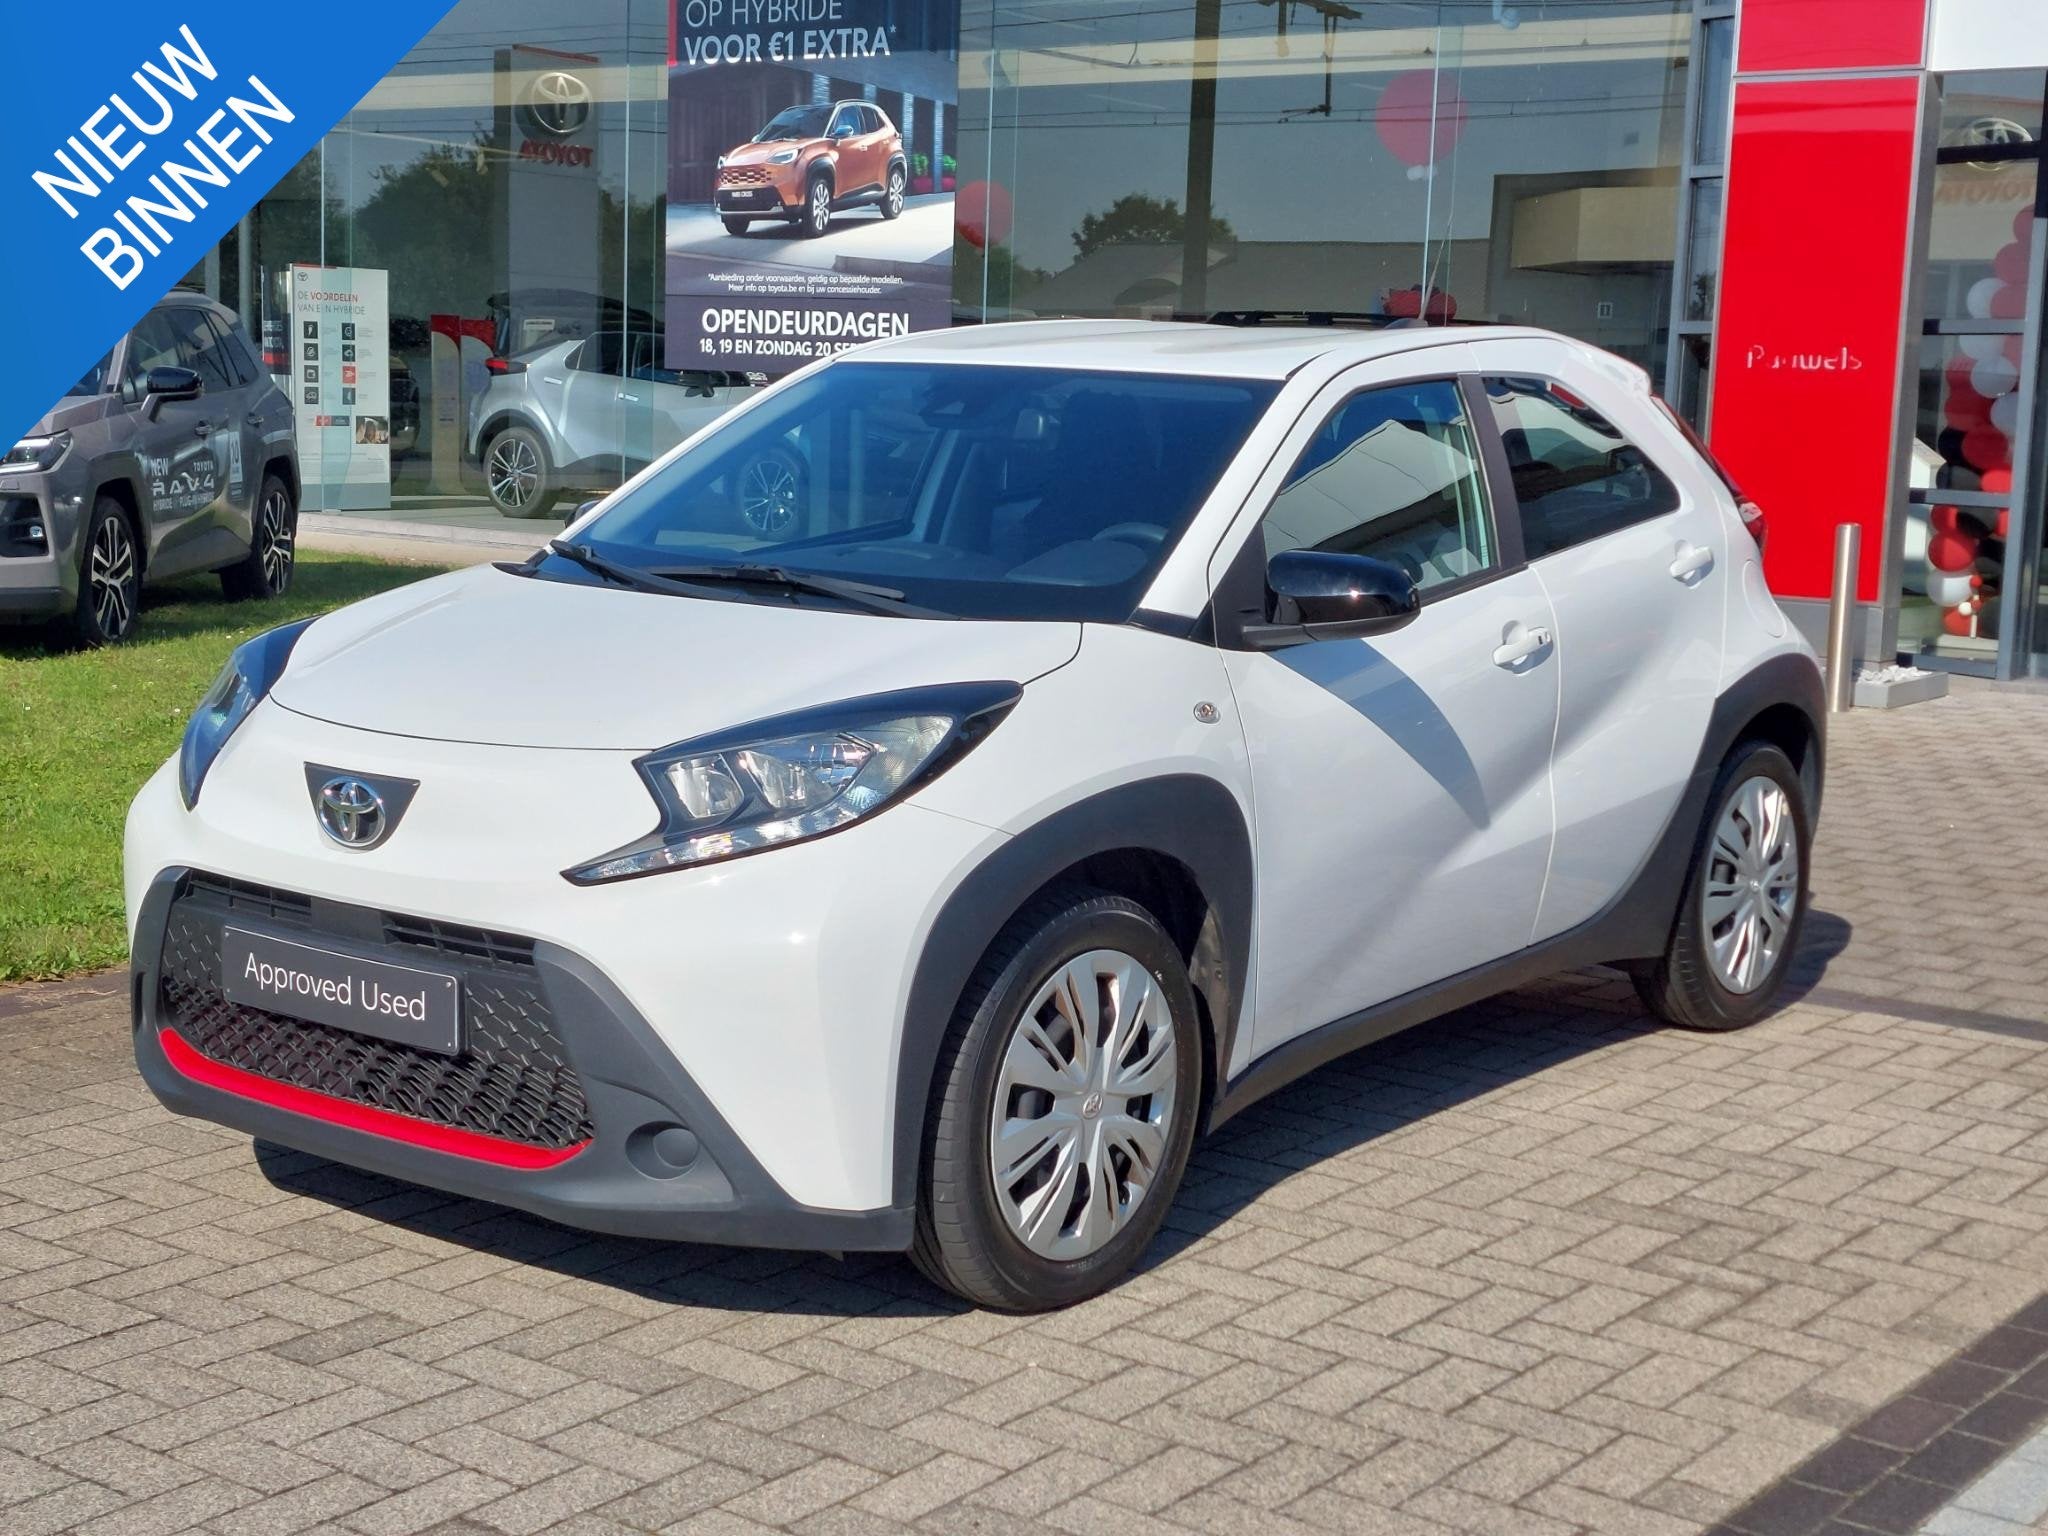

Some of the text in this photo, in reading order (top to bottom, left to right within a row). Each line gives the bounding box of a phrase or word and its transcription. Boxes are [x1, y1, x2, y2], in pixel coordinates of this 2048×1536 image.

[686, 0, 842, 27] OP HYBRIDE
[684, 33, 762, 65] VOOR
[768, 32, 794, 62] €1
[728, 283, 744, 292] Meer
[758, 285, 767, 293] op
[829, 276, 838, 284] op
[840, 275, 870, 284] bepaalde
[297, 291, 309, 300] DE
[297, 303, 314, 312] VAN
[316, 304, 331, 313] EN
[702, 308, 909, 338] OPENDEURDAGEN
[700, 338, 716, 355] 18,
[719, 339, 733, 353] 19
[736, 339, 753, 354] EN
[756, 340, 812, 356] ZONDAG
[815, 341, 831, 357] 20
[150, 458, 168, 476] NEW
[193, 461, 213, 472] TOYOTA
[152, 474, 214, 496] RAV4
[244, 952, 426, 1021] Approved Used
